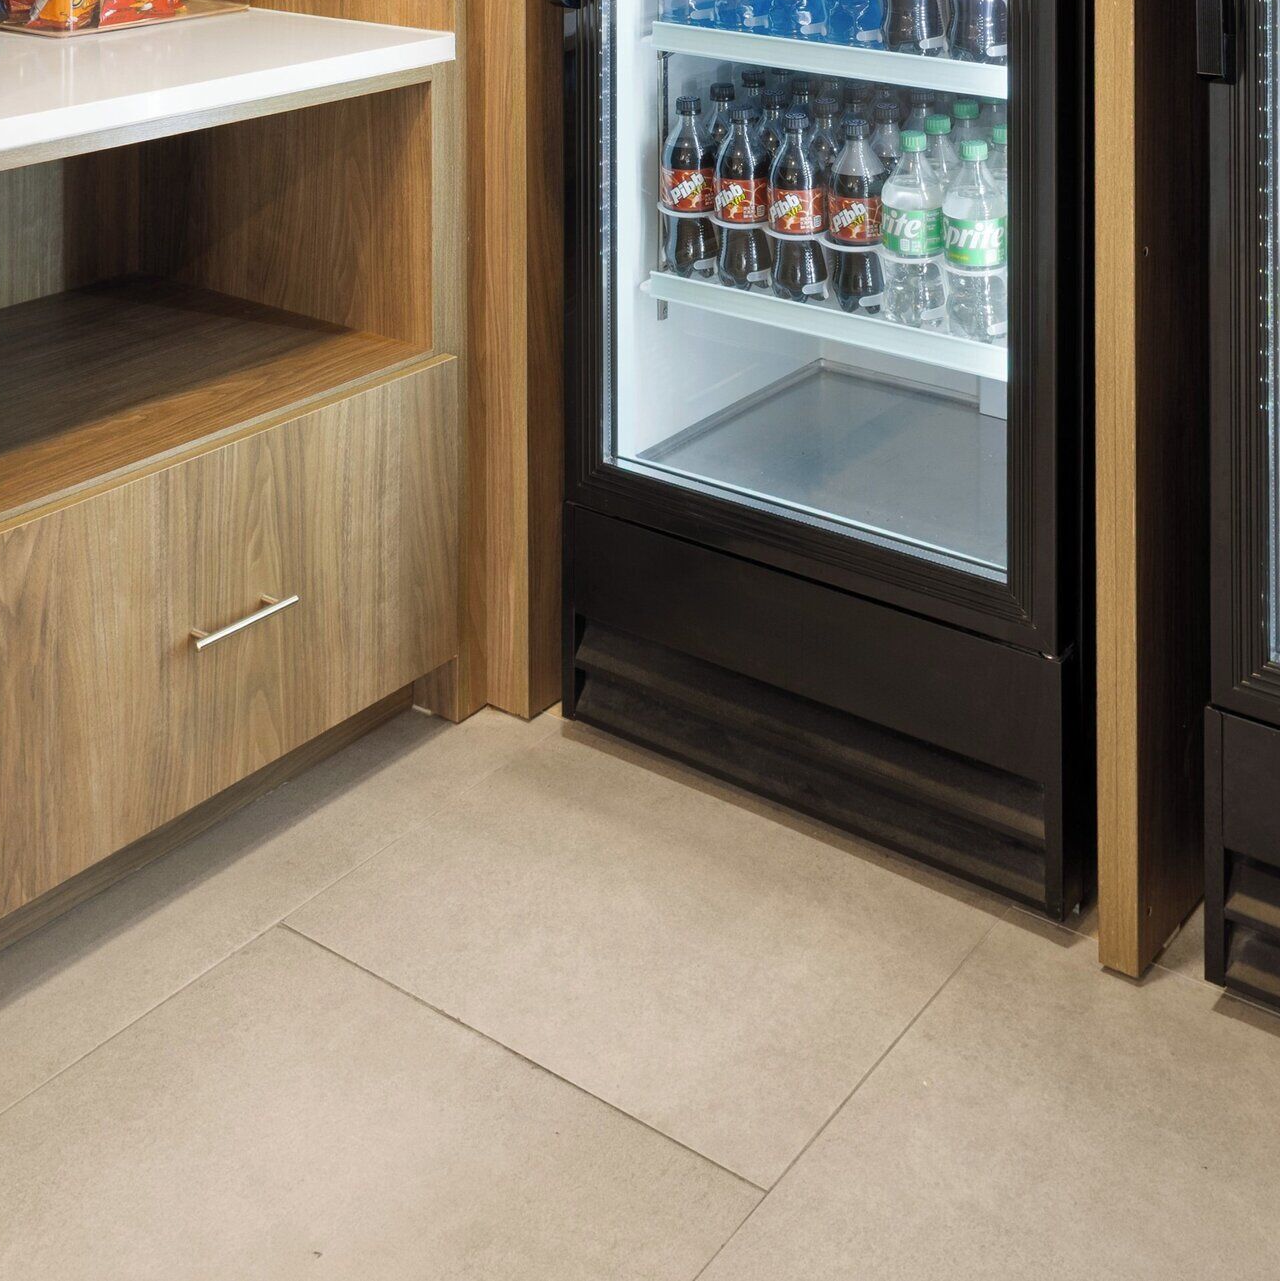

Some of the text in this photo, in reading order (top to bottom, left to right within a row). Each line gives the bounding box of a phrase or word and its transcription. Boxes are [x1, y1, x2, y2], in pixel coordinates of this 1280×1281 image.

[670, 173, 706, 204] Pibb
[714, 183, 744, 211] Pibb
[730, 193, 747, 206] Xtra
[770, 193, 801, 222] Pibb
[786, 205, 802, 217] Xtra
[832, 202, 867, 233] Pibb
[882, 210, 921, 239] rite
